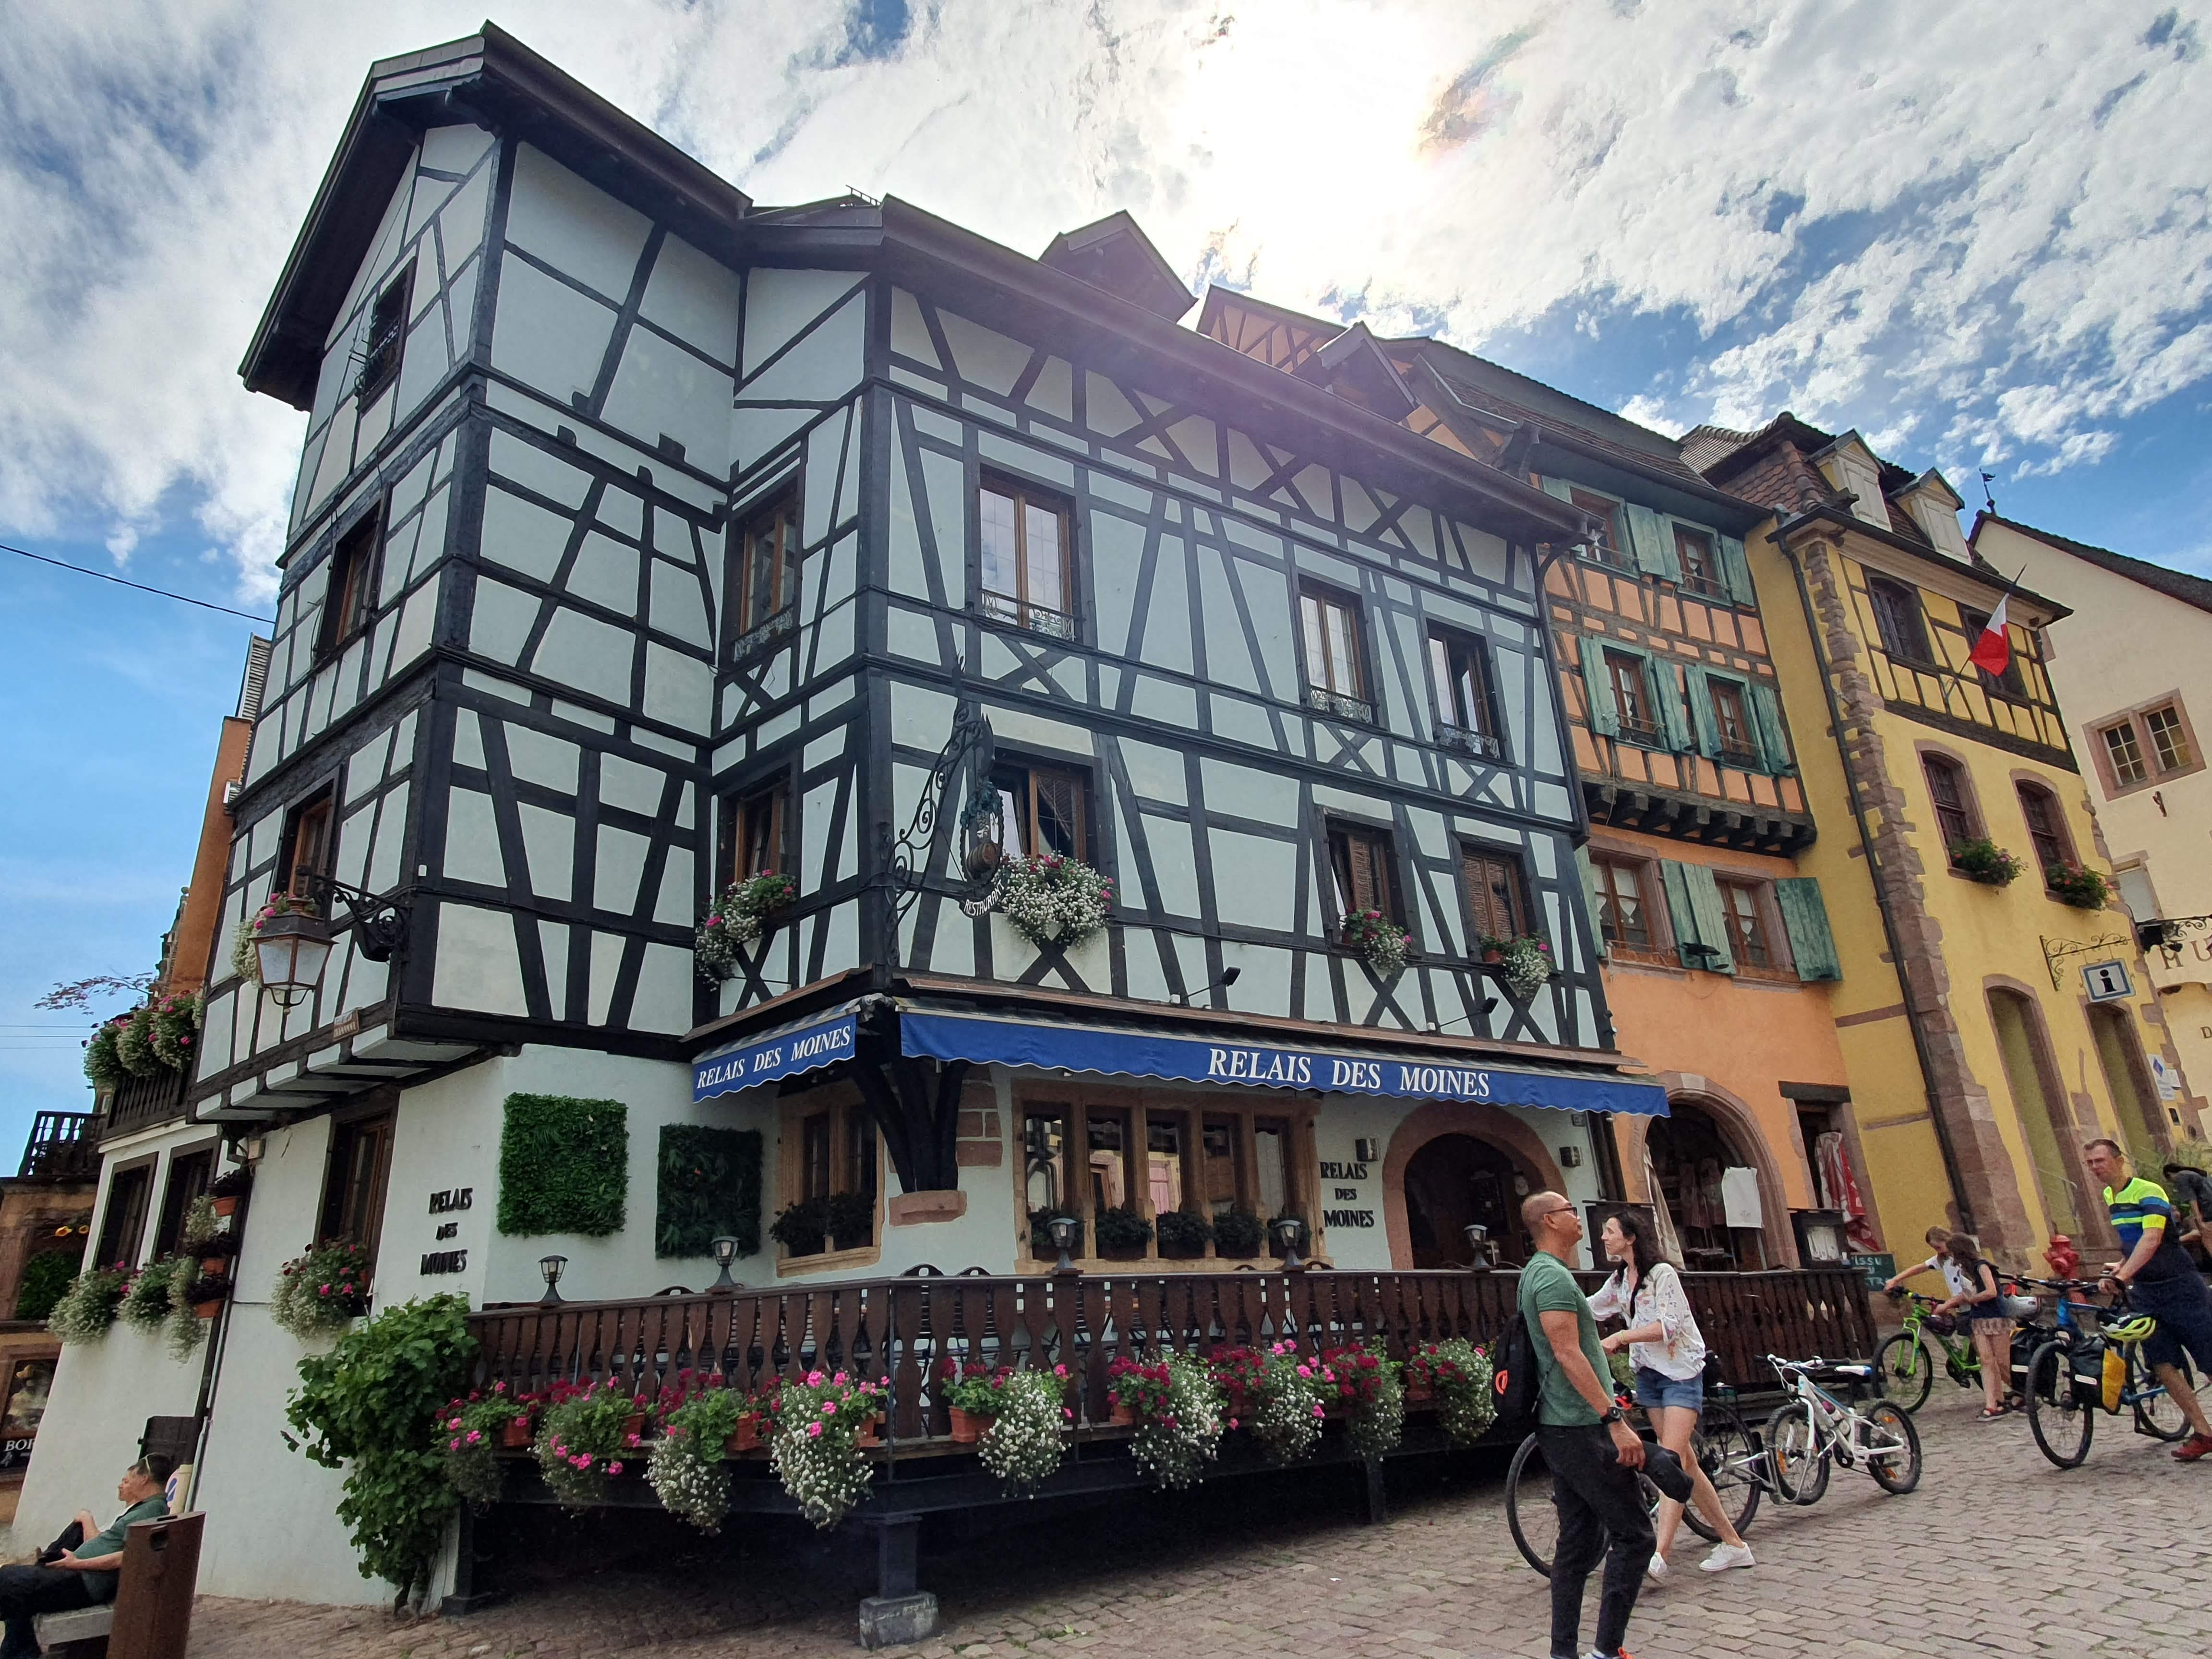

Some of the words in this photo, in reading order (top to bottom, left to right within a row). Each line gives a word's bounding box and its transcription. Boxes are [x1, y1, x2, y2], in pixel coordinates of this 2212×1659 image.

[964, 879, 1004, 916] RESTAURANT
[697, 1058, 745, 1089] RELAIS
[753, 1047, 781, 1073] DES
[791, 1025, 851, 1061] MOINES
[1208, 1048, 1311, 1083] RELAIS
[1331, 1060, 1381, 1089] DES
[1399, 1066, 1489, 1097] MOINES
[1320, 1162, 1368, 1179] RELAIS
[429, 1188, 473, 1214] RELAIS
[1334, 1188, 1357, 1201] DES
[436, 1222, 458, 1240] DES
[1323, 1210, 1374, 1227] MOINES
[420, 1249, 468, 1275] MOINES
